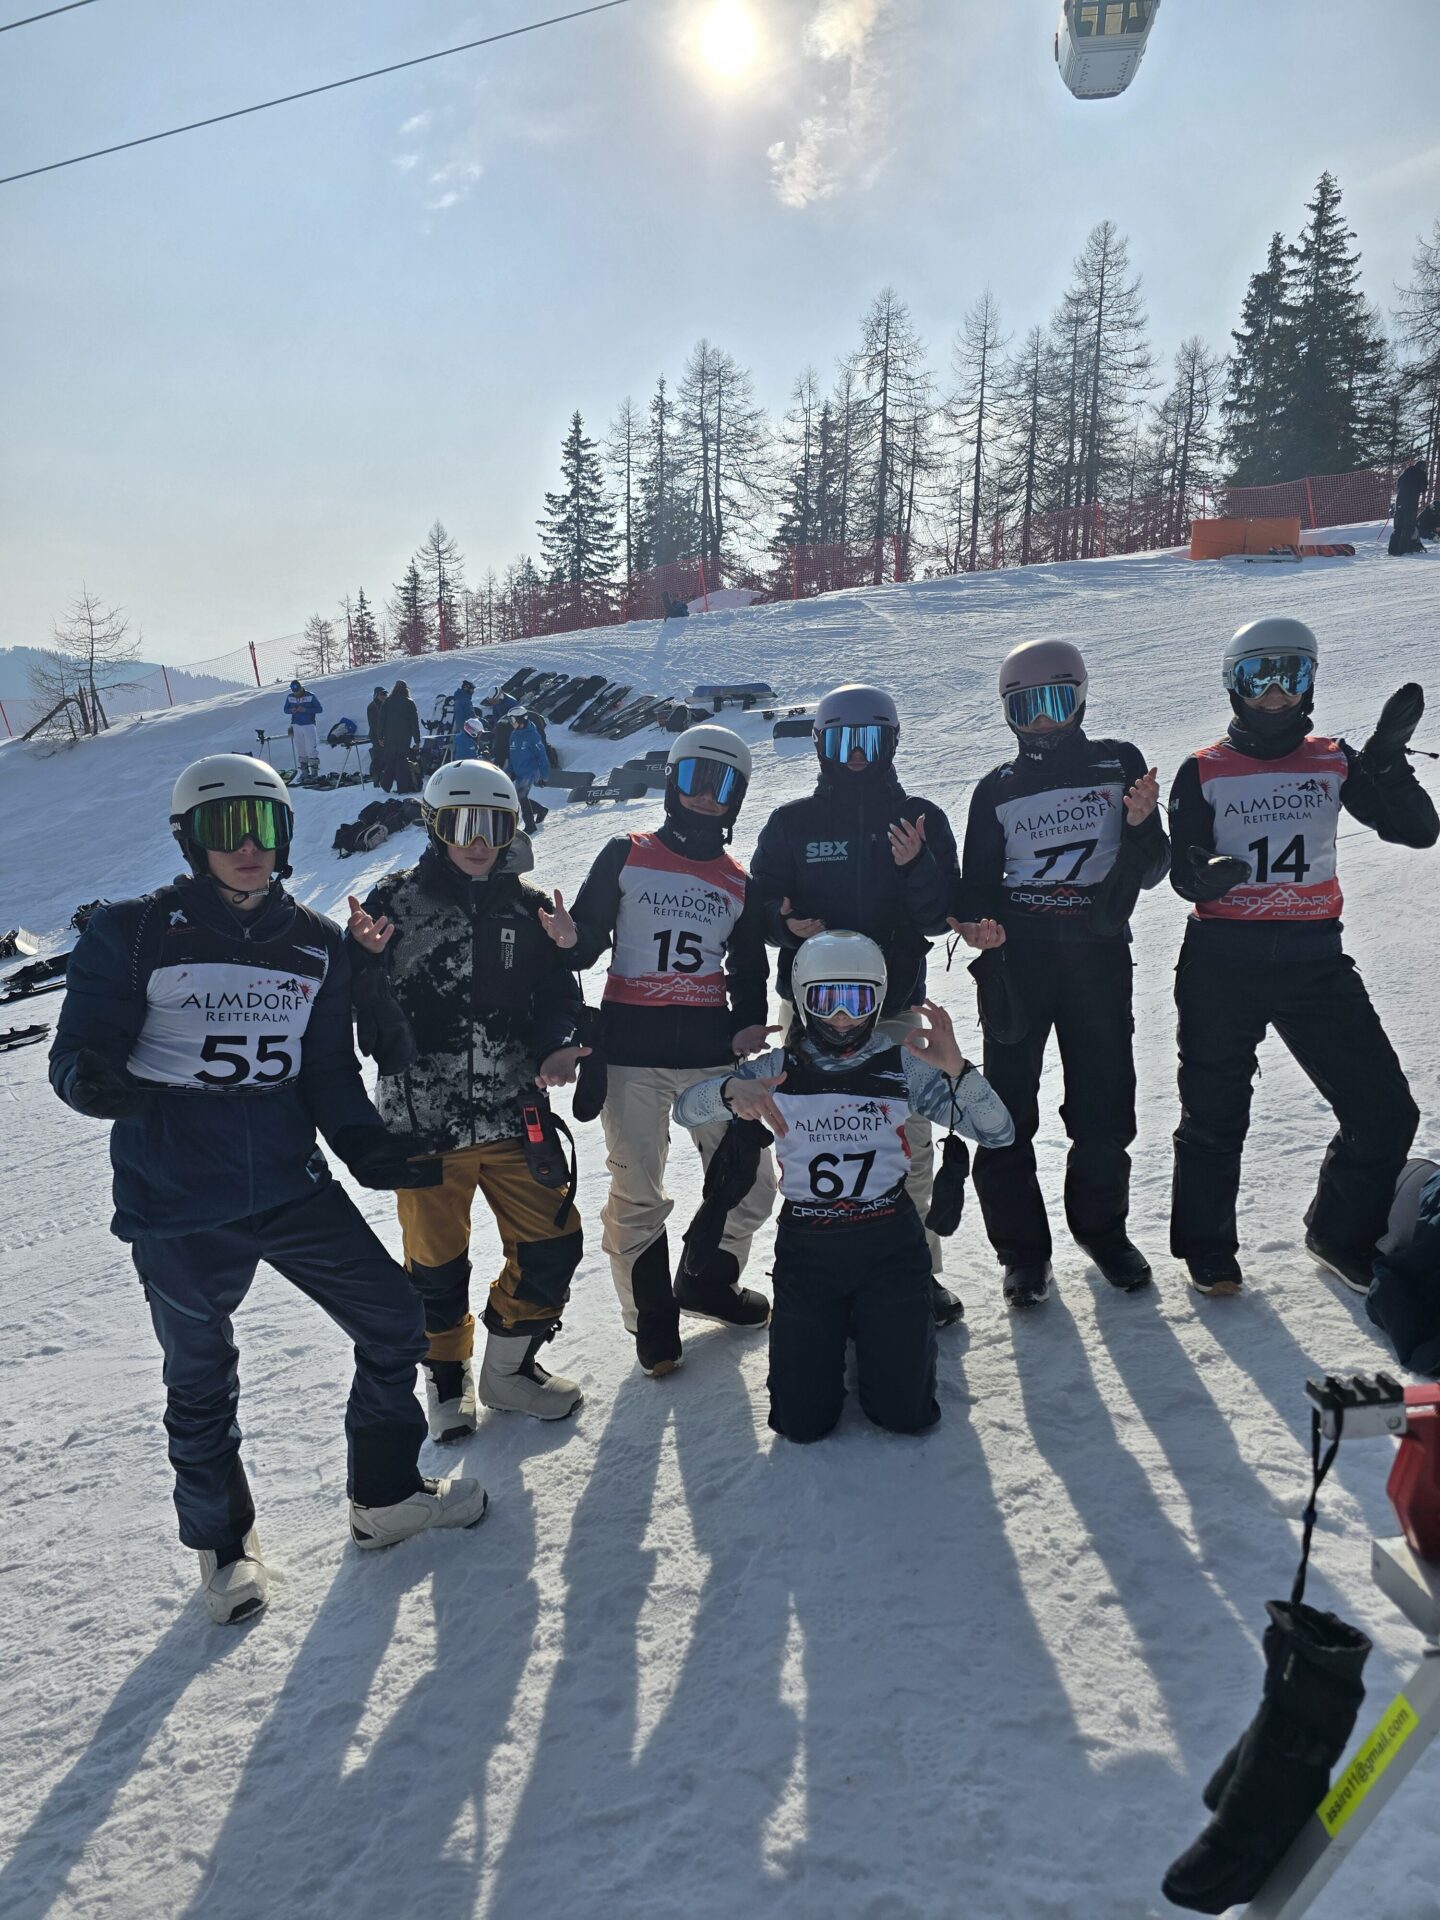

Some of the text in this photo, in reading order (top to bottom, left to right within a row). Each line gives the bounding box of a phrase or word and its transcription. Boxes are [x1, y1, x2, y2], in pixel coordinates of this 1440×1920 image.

[586, 788, 620, 798] TELOS
[1224, 794, 1325, 817] ALMDORF
[1014, 803, 1108, 834] ALMDORF
[1243, 811, 1312, 825] REITERALM
[1030, 821, 1096, 841] REITERALM
[805, 840, 849, 858] SBX
[1248, 834, 1311, 883] 14
[1031, 838, 1099, 882] 77
[638, 891, 725, 918] ALMDORF
[1010, 891, 1096, 907] CROSSPA
[1218, 894, 1333, 909] CROSSPARK
[653, 906, 712, 926] REITERALM
[653, 929, 705, 974] 15
[624, 978, 722, 996] CROSSPARK
[180, 992, 304, 1010] ALMDORF
[205, 1011, 290, 1023] REITERALM
[193, 1034, 293, 1086] 55
[795, 1116, 882, 1132] ALMDORF
[809, 1133, 869, 1143] REITERALM
[808, 1149, 877, 1200] 67
[1325, 1708, 1409, 1825] assiro11@gmail.com
